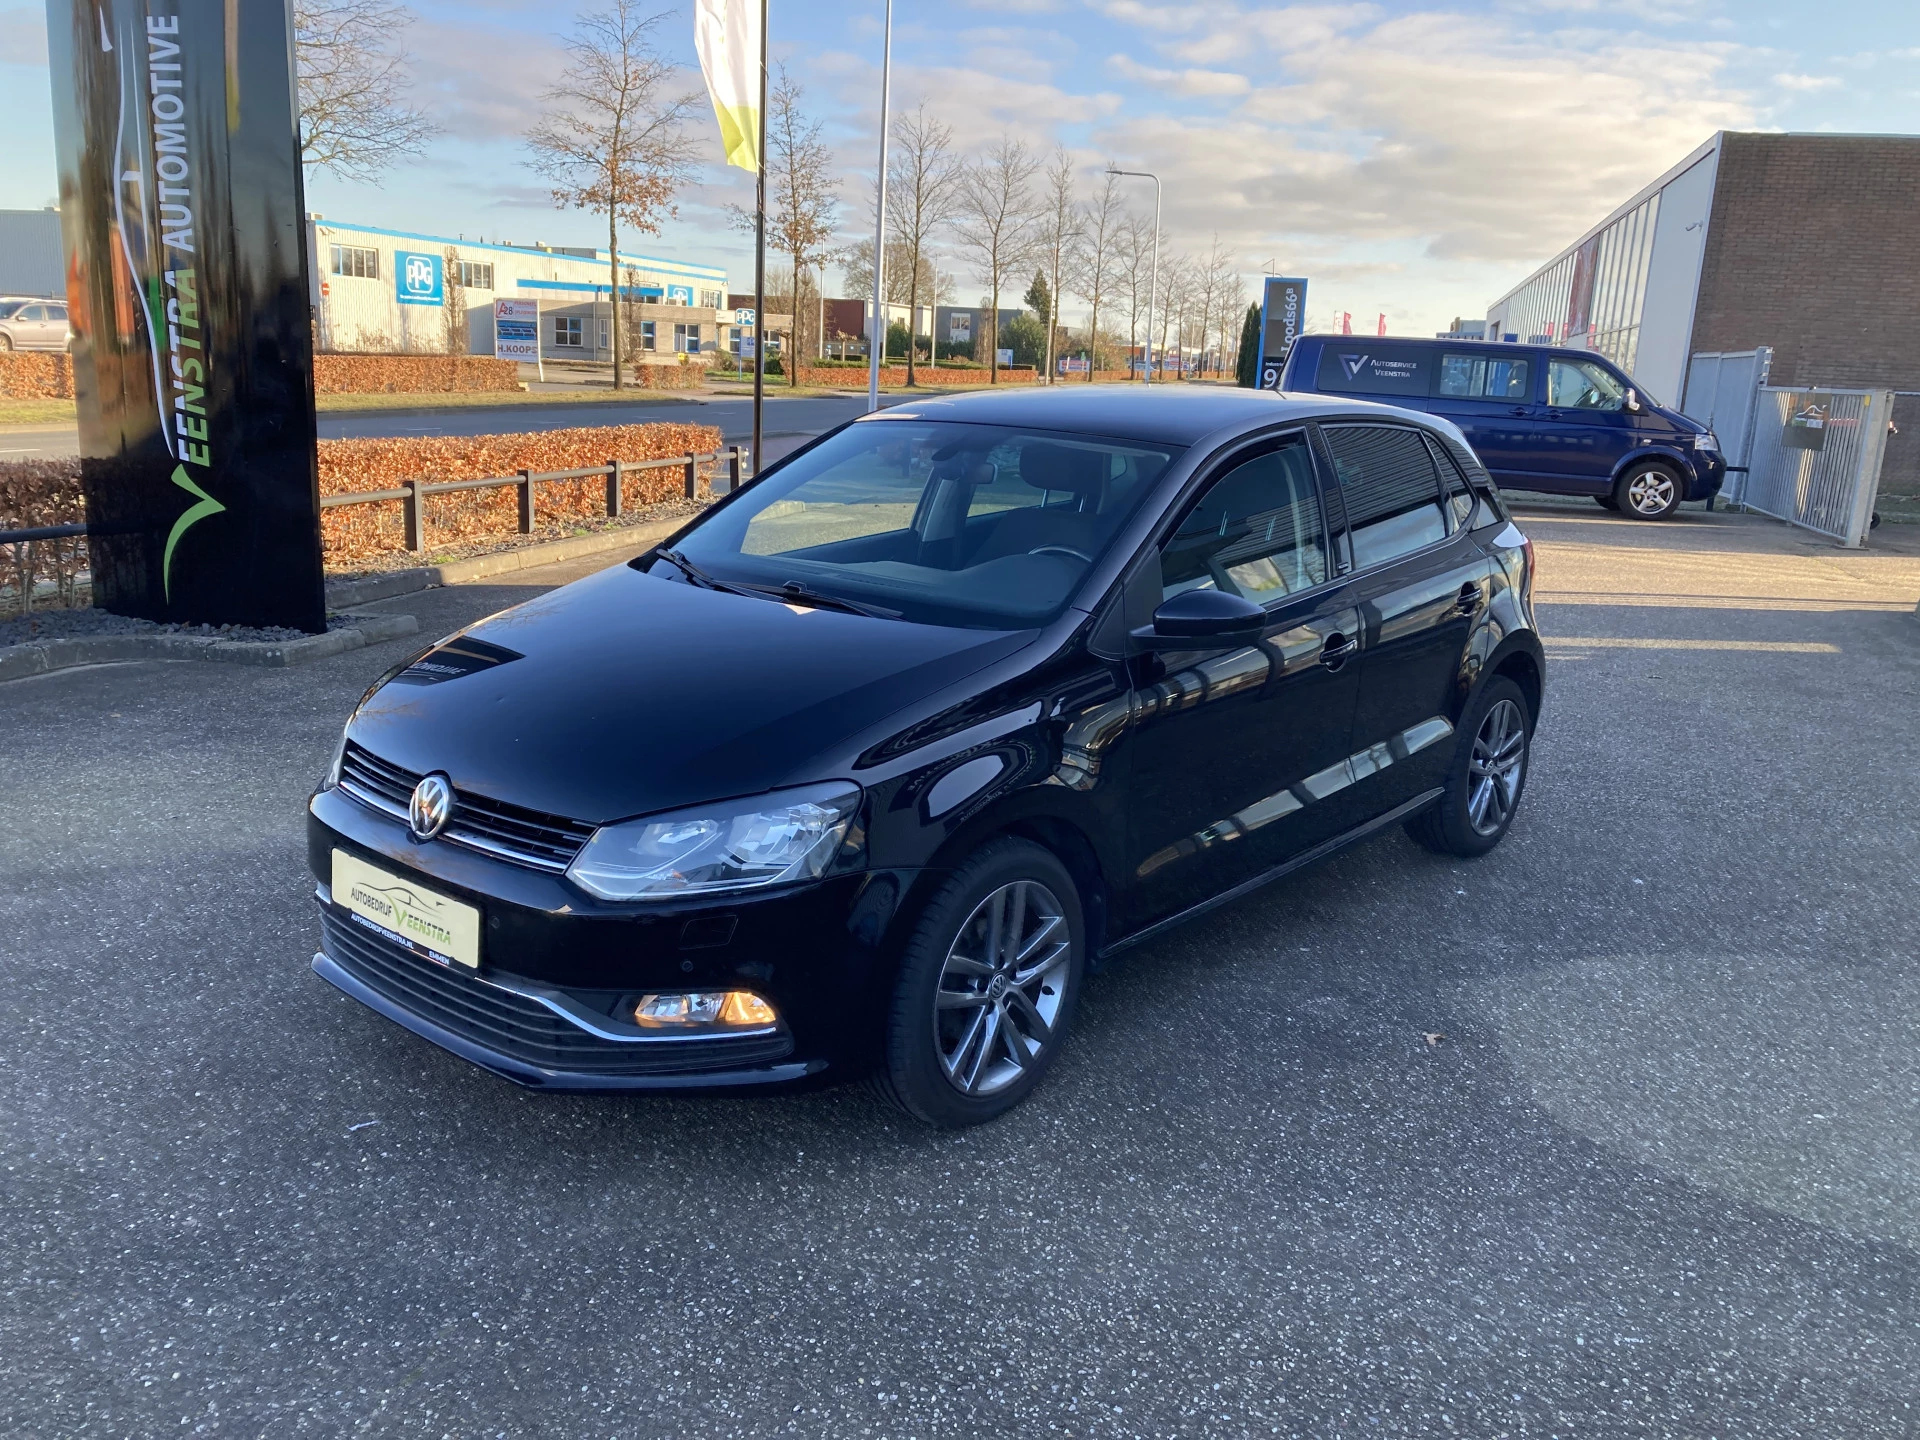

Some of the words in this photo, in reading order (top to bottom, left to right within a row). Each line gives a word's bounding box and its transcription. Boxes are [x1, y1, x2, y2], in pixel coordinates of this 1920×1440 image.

[147, 15, 195, 253] AUTOMOTIVE
[407, 260, 431, 289] PPG
[737, 310, 755, 323] PPG
[1370, 360, 1417, 369] AUTOSERVICE
[1263, 369, 1277, 388] 9
[1375, 369, 1411, 378] VEENSTRA
[350, 887, 392, 918] AUTOBEDRIJF
[428, 950, 450, 965] EMMEN
